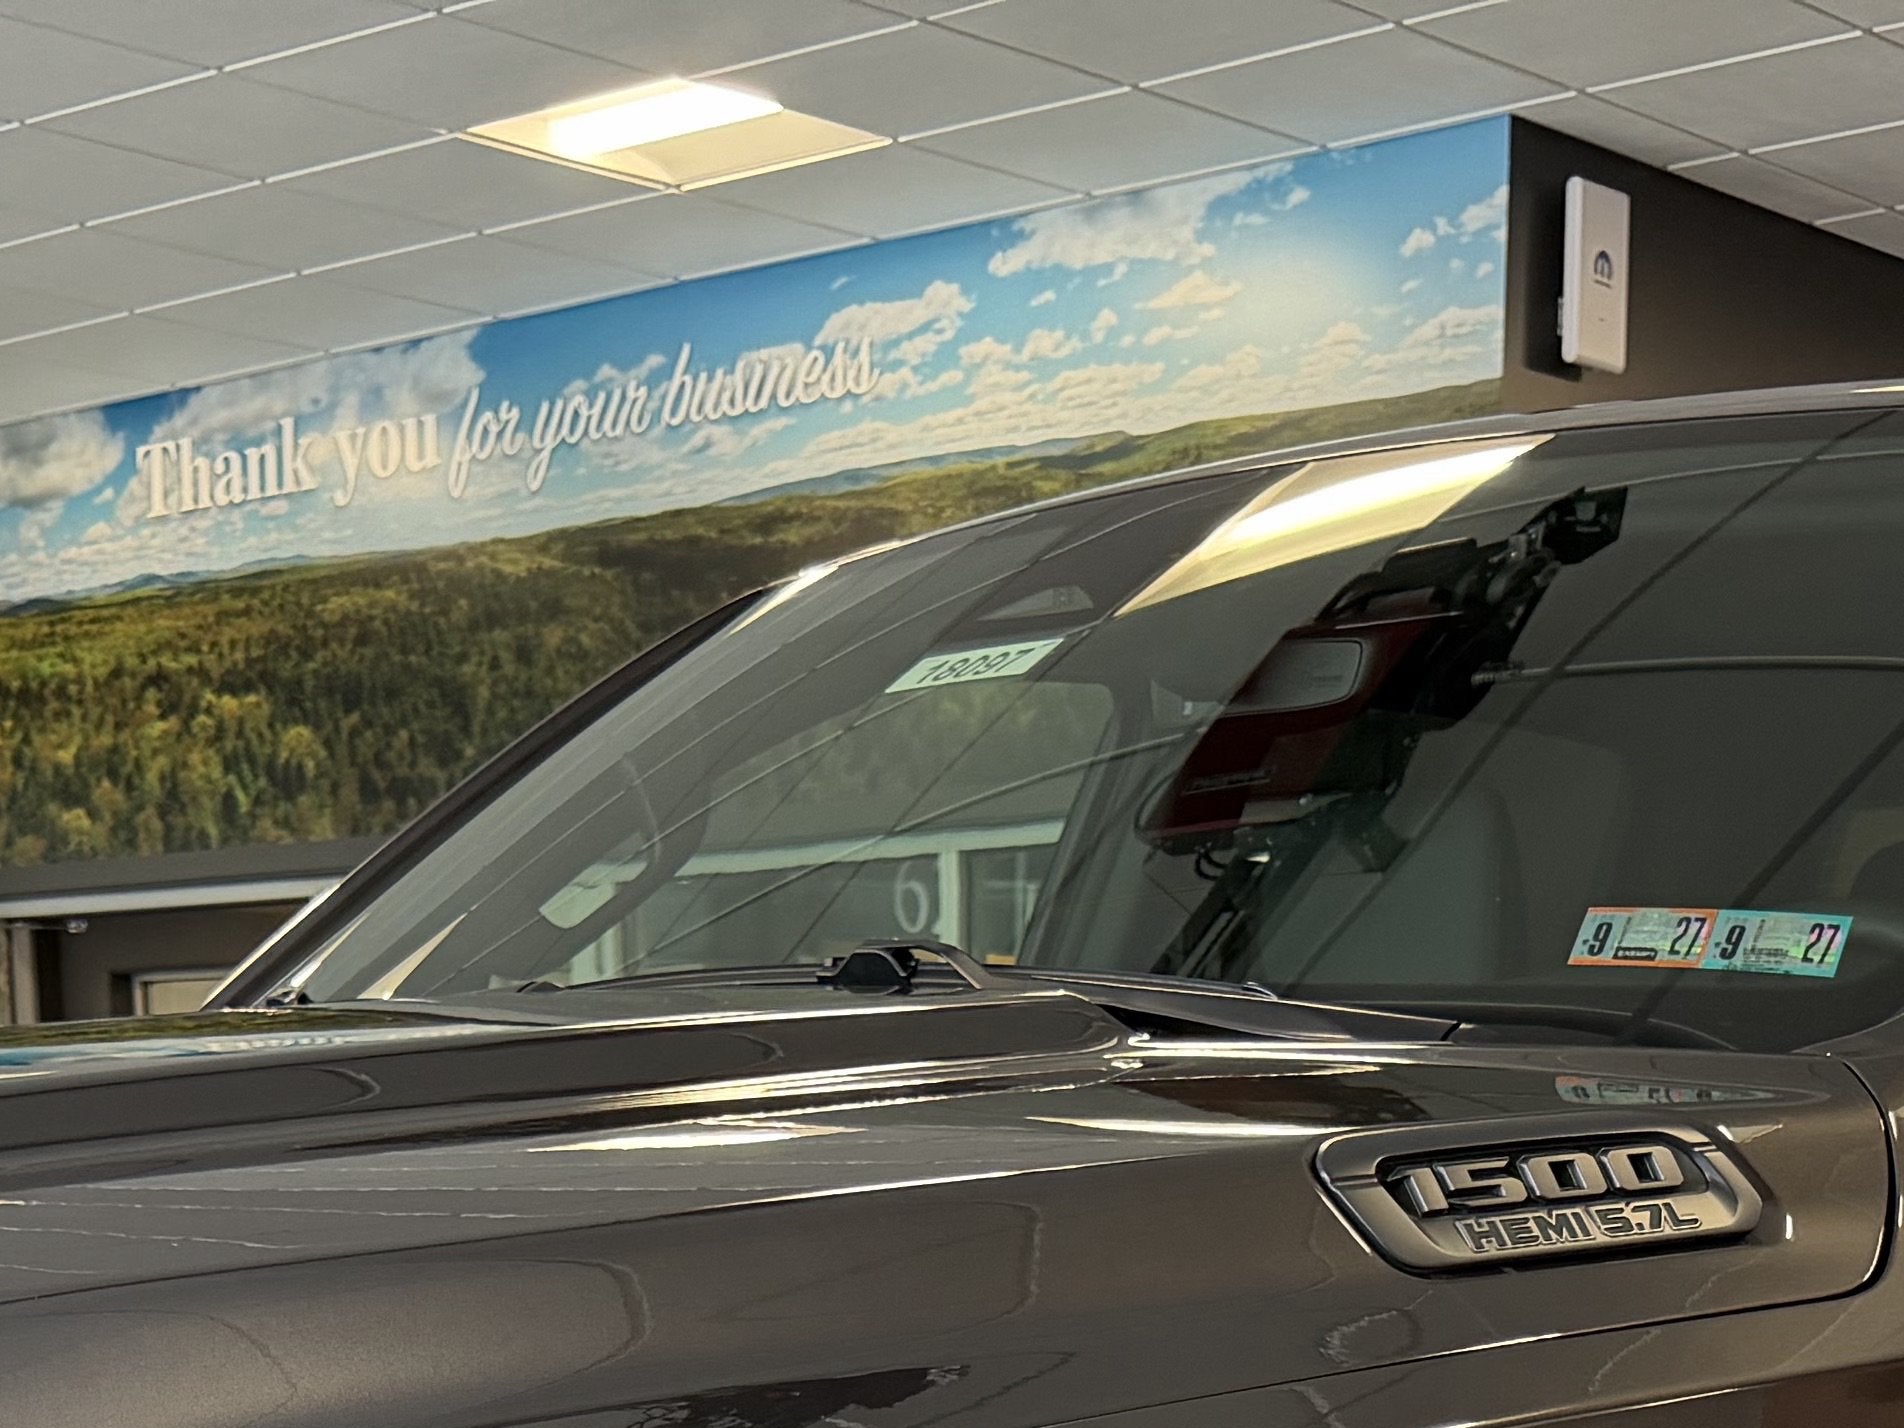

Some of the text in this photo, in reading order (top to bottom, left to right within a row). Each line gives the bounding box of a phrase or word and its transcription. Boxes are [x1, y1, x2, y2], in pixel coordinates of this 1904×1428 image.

[136, 339, 882, 520] Thank you for your business
[916, 647, 1037, 685] 18097
[1586, 921, 1614, 957] 9
[1667, 916, 1708, 960] 27
[1718, 924, 1746, 961] 9
[1800, 922, 1841, 965] 27
[1386, 1144, 1685, 1218] 1500
[1456, 1202, 1703, 1254] HEMI 5.7L
